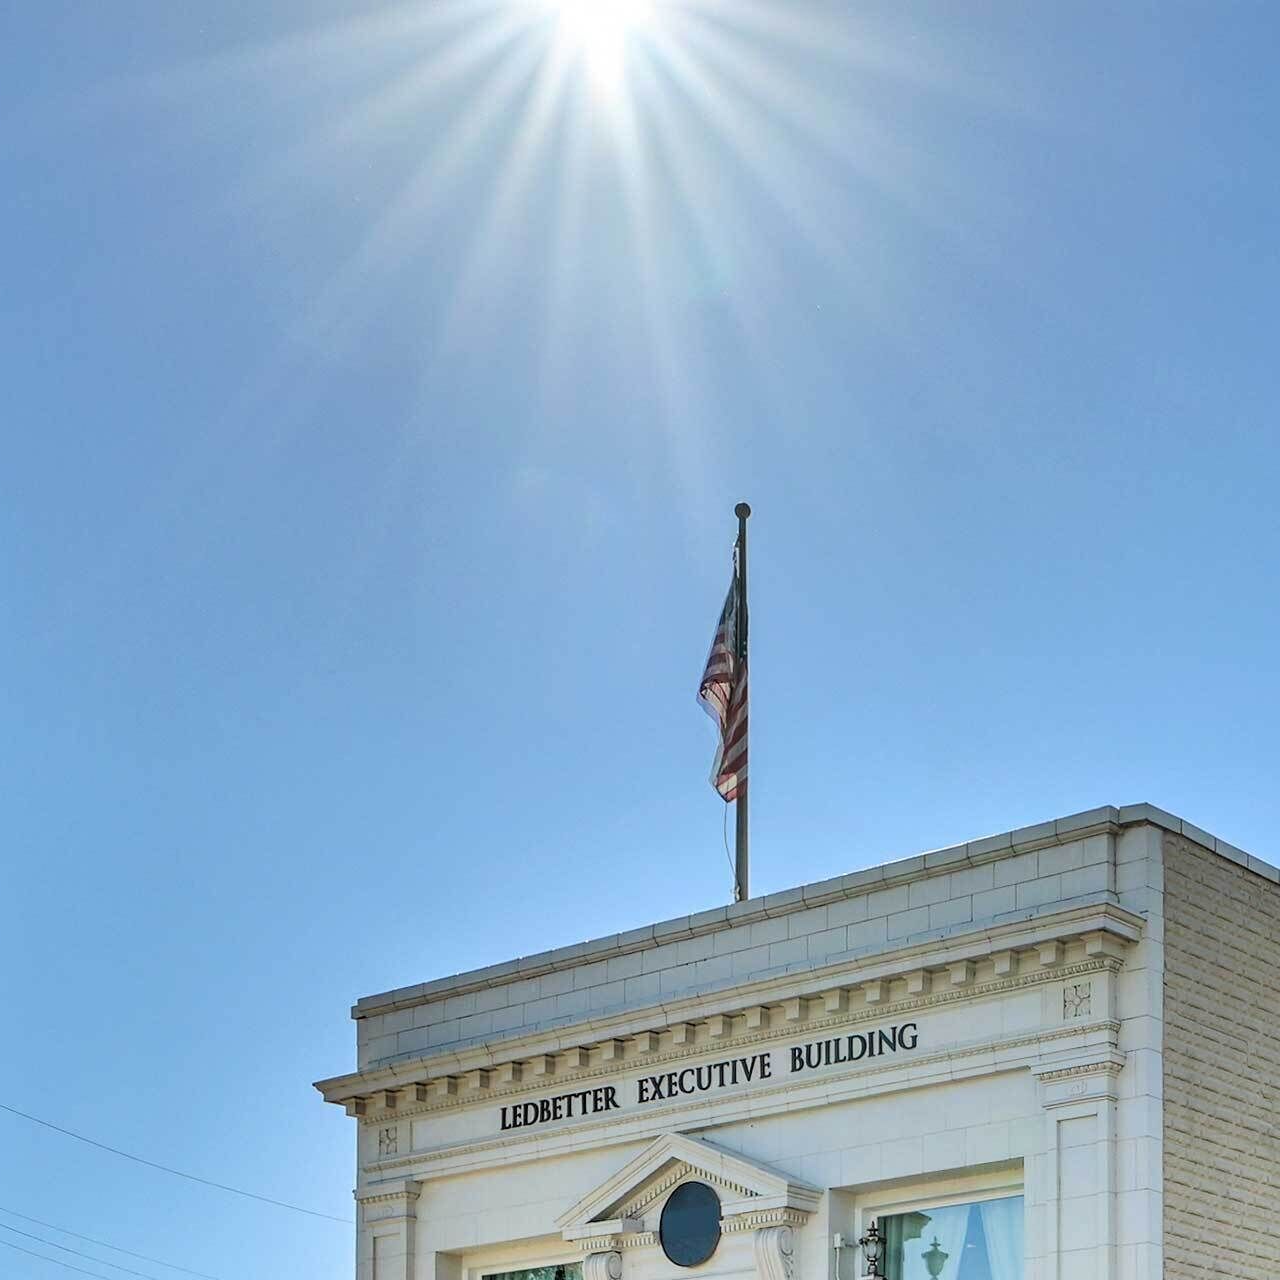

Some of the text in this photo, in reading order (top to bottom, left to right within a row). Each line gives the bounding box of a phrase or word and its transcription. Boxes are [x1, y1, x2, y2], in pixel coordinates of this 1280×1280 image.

[500, 1023, 918, 1130] LEDBETTER EXECUTIVE BUILDING
